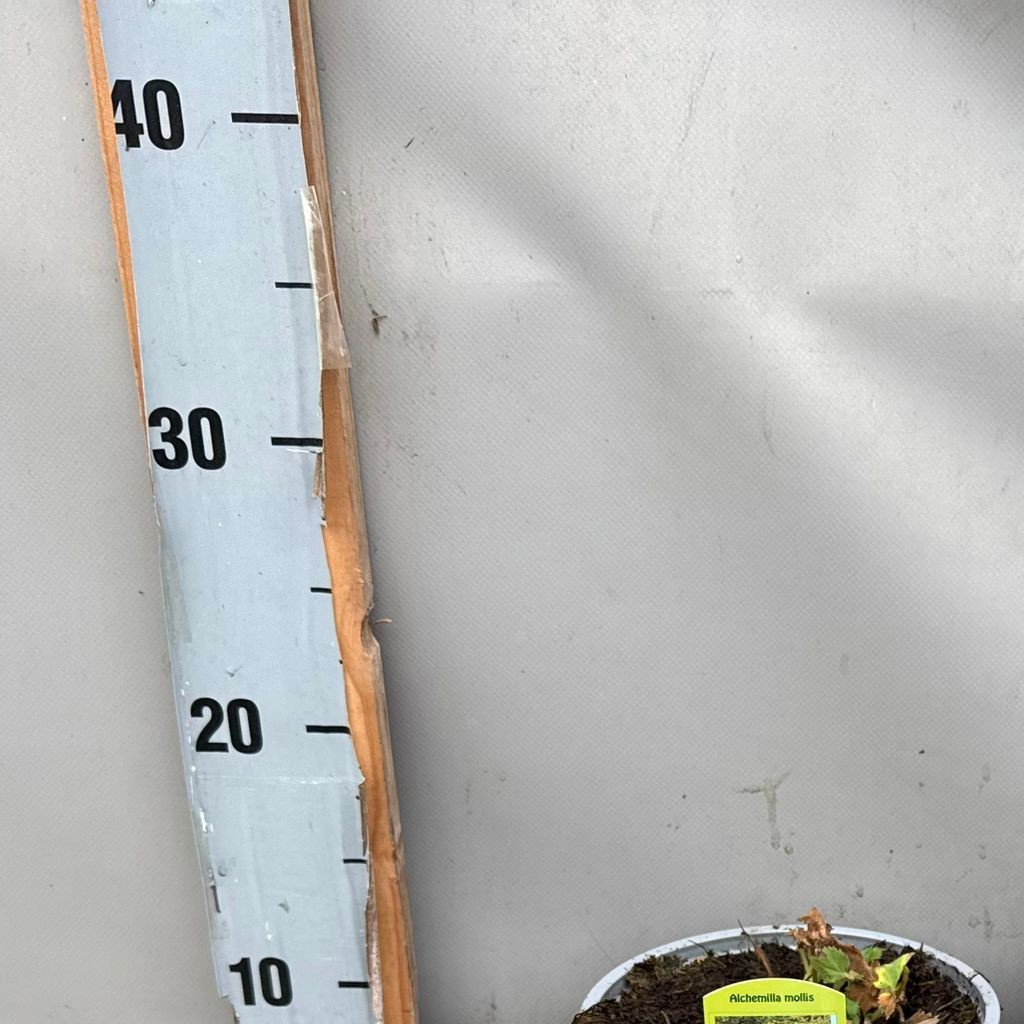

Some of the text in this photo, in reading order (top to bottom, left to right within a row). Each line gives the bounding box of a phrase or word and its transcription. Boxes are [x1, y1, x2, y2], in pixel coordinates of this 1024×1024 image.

[111, 79, 185, 152] 40
[148, 406, 227, 471] 30
[190, 697, 263, 755] 20
[229, 957, 293, 1007] 10
[729, 992, 815, 1003] Alchemilla mollis
